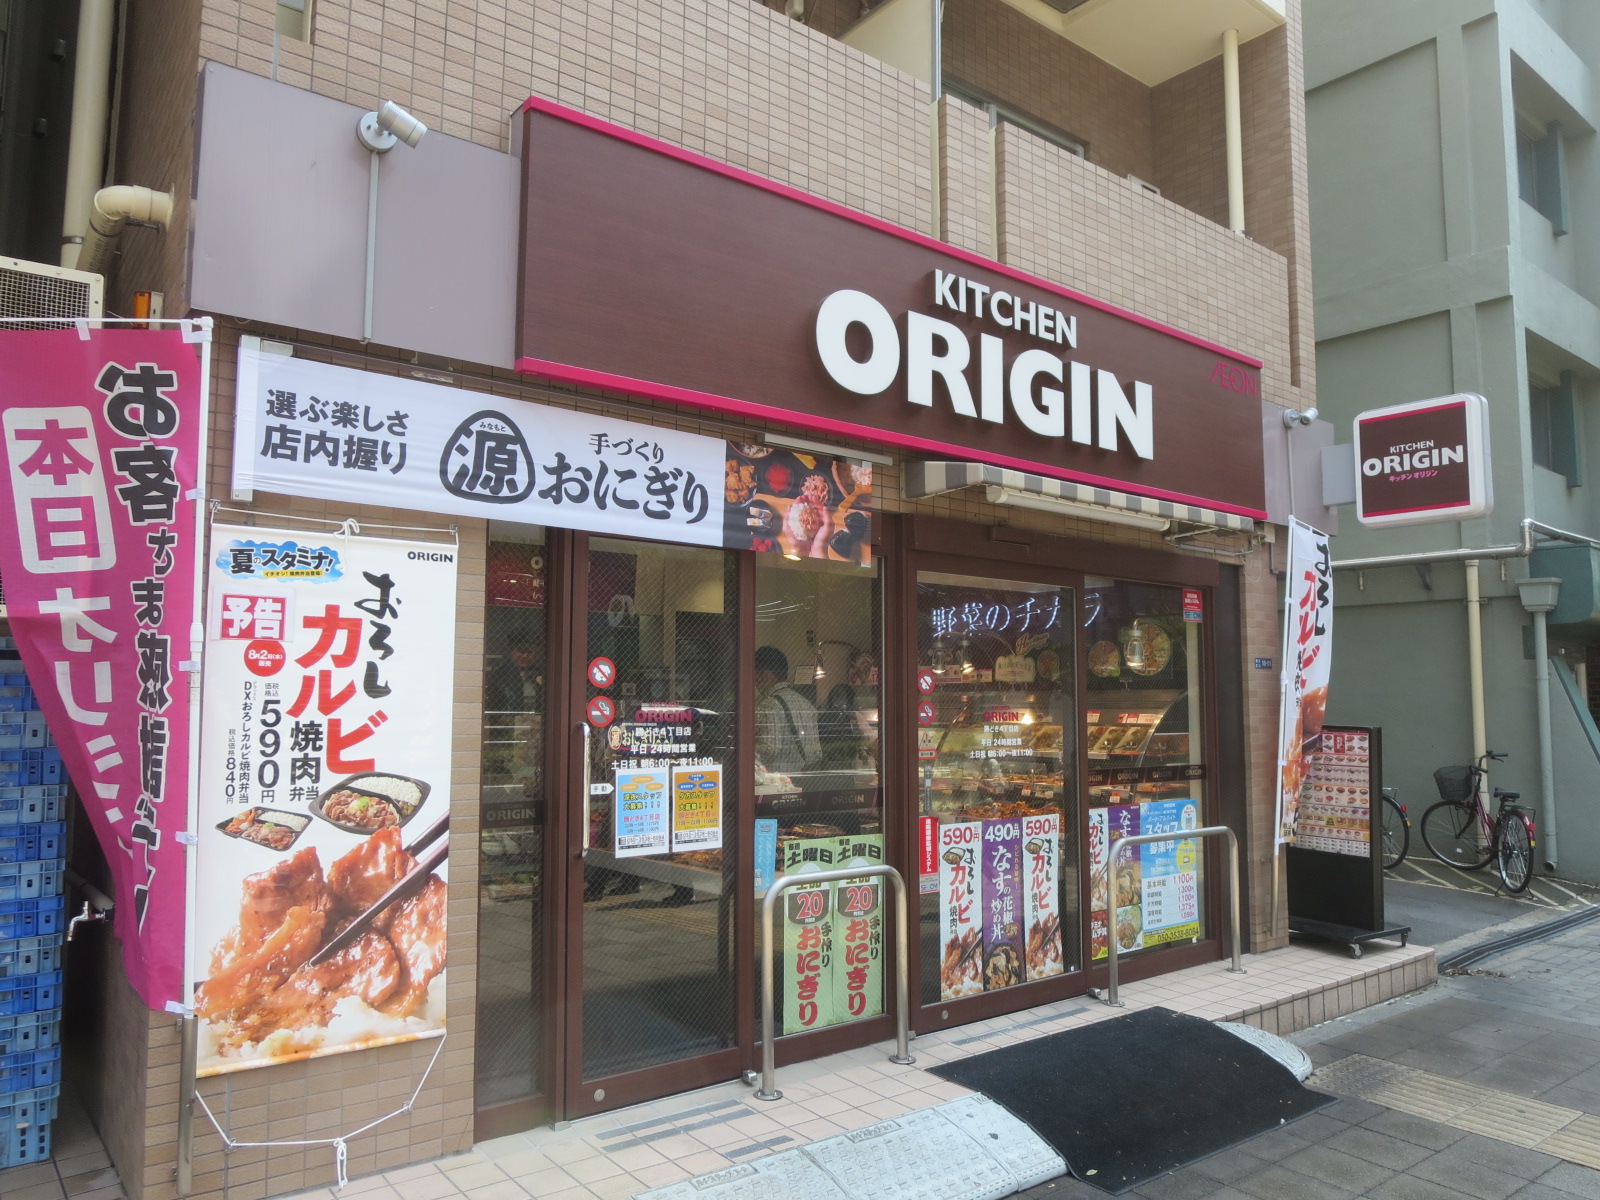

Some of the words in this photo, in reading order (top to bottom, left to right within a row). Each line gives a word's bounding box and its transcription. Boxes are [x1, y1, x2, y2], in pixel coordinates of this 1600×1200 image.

[935, 268, 1077, 348] KITCHEN
[816, 289, 1153, 460] ORIGIN
[266, 389, 410, 436] 選ぶ楽しさ
[479, 421, 506, 432] みなもと
[260, 424, 407, 475] 店内握り
[452, 428, 519, 496] 源
[589, 432, 665, 464] 手づくり
[1363, 445, 1464, 476] ORIGIN
[1390, 440, 1434, 453] KITCHEN
[538, 453, 709, 525] おにぎり
[1389, 473, 1412, 482] キッチン
[1413, 470, 1438, 479] オリジン
[407, 551, 453, 563] ORIGIN
[1314, 541, 1332, 636] おろし
[223, 597, 283, 638] 予告
[354, 570, 402, 699] おろし
[285, 604, 389, 775] カルビ
[634, 709, 693, 722] ORIGIN
[984, 711, 1019, 722] ORIGIN
[984, 724, 1019, 733] 勝どき4丁目店
[238, 681, 253, 804] DXおろしカルビ焼肉弁当
[257, 699, 282, 803] 590円
[630, 744, 647, 754] 平日
[650, 743, 696, 754] 24時間営業
[969, 751, 986, 759] 土日祝
[981, 738, 991, 747] 平日
[994, 738, 1022, 746] 24時間営業
[611, 759, 637, 770] 土日祝
[1089, 774, 1102, 782] IGIN
[486, 808, 536, 820] ORIGIN
[1145, 821, 1179, 835] スタッフ
[786, 847, 832, 869] 土曜日
[837, 843, 881, 864] 土曜日
[964, 848, 976, 895] おろし
[1043, 838, 1053, 882] おろし
[845, 885, 872, 912] 20
[948, 862, 974, 924] カルビ
[1031, 852, 1051, 909] カルビ
[796, 891, 823, 919] 20
[821, 921, 833, 968] 手作り
[869, 915, 880, 960] 手作り
[796, 925, 822, 1026] おにぎり
[845, 918, 870, 1016] おにぎり
